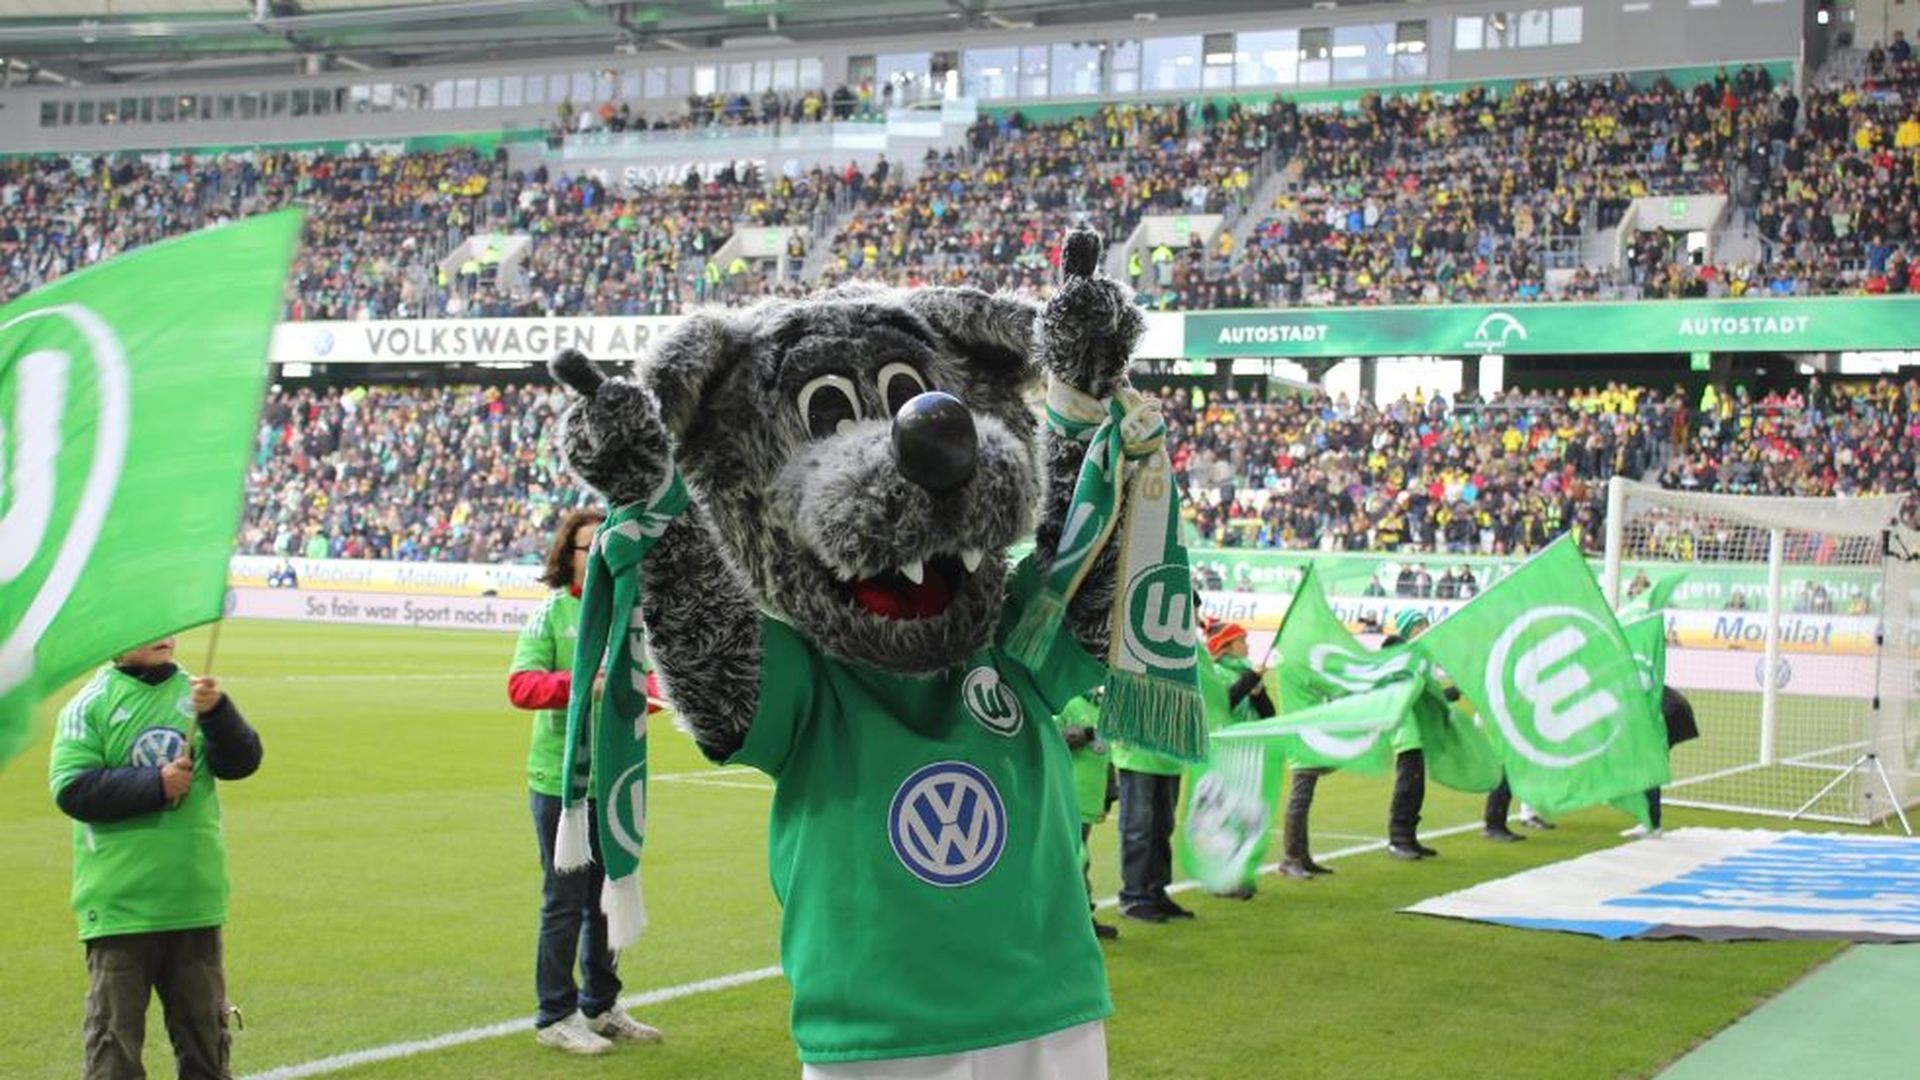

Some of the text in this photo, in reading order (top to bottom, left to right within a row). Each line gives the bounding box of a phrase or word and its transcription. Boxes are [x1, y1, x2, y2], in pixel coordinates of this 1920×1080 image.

[1218, 326, 1328, 344] AUTOSTADT
[1678, 317, 1809, 335] AUTOSTADT
[365, 325, 594, 356] VOLKSWAGEN
[305, 595, 529, 627] So fair war Sport noch nie
